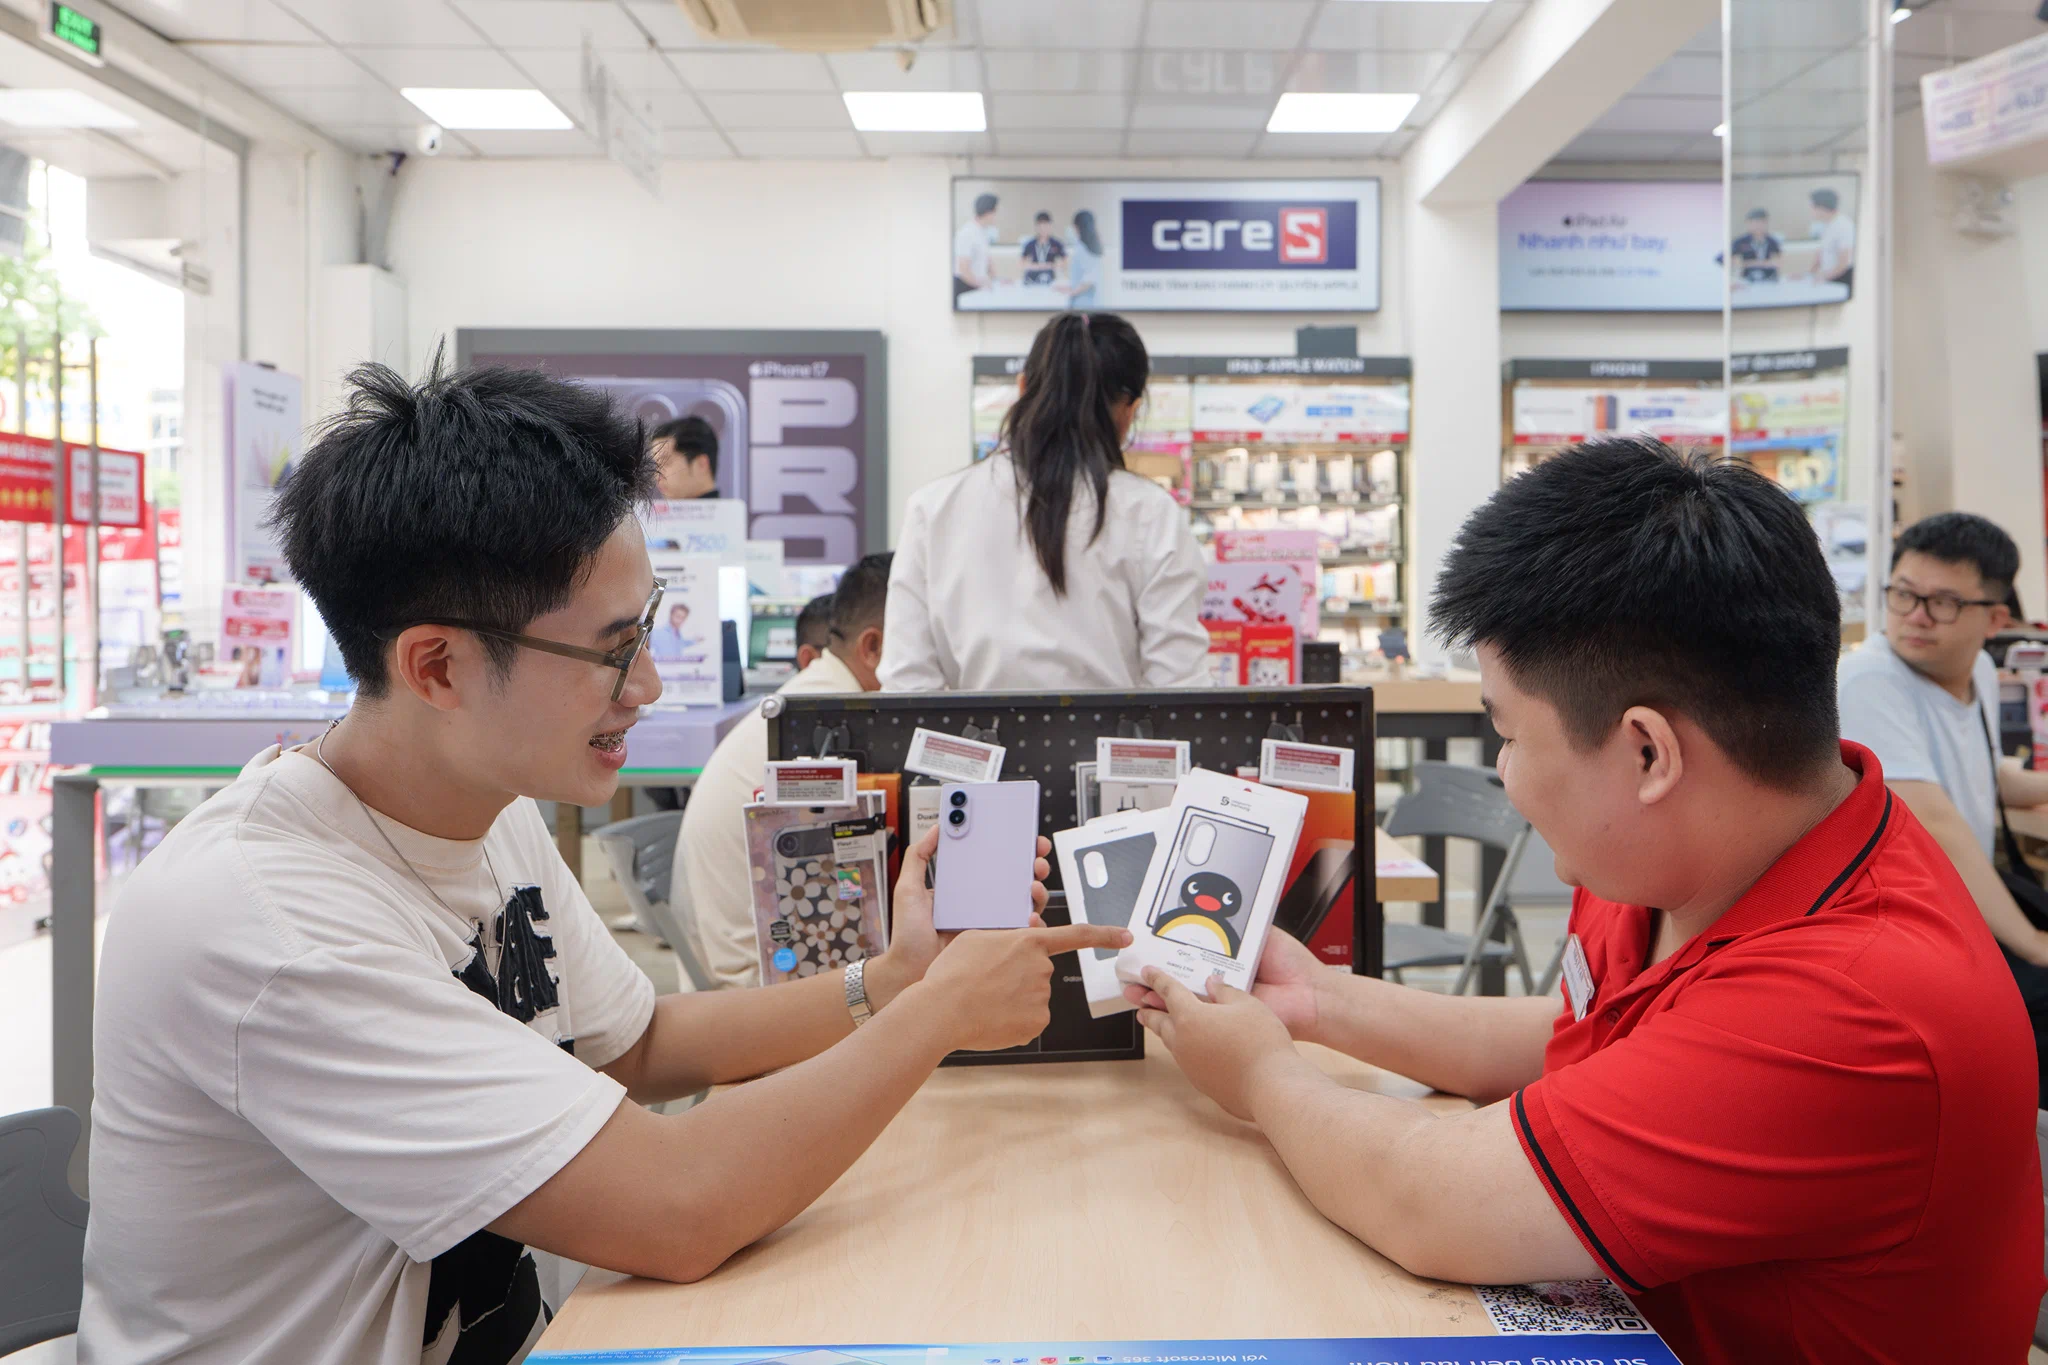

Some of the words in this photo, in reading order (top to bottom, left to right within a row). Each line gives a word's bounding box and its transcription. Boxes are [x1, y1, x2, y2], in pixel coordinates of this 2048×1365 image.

[1152, 218, 1274, 251] care
[1518, 232, 1584, 249] Nhanh
[760, 361, 812, 377] iPhone
[813, 361, 830, 377] 17
[1313, 358, 1365, 373] WATCH
[1590, 361, 1650, 376] IPHONE
[1156, 1354, 1237, 1363] Microsoft
